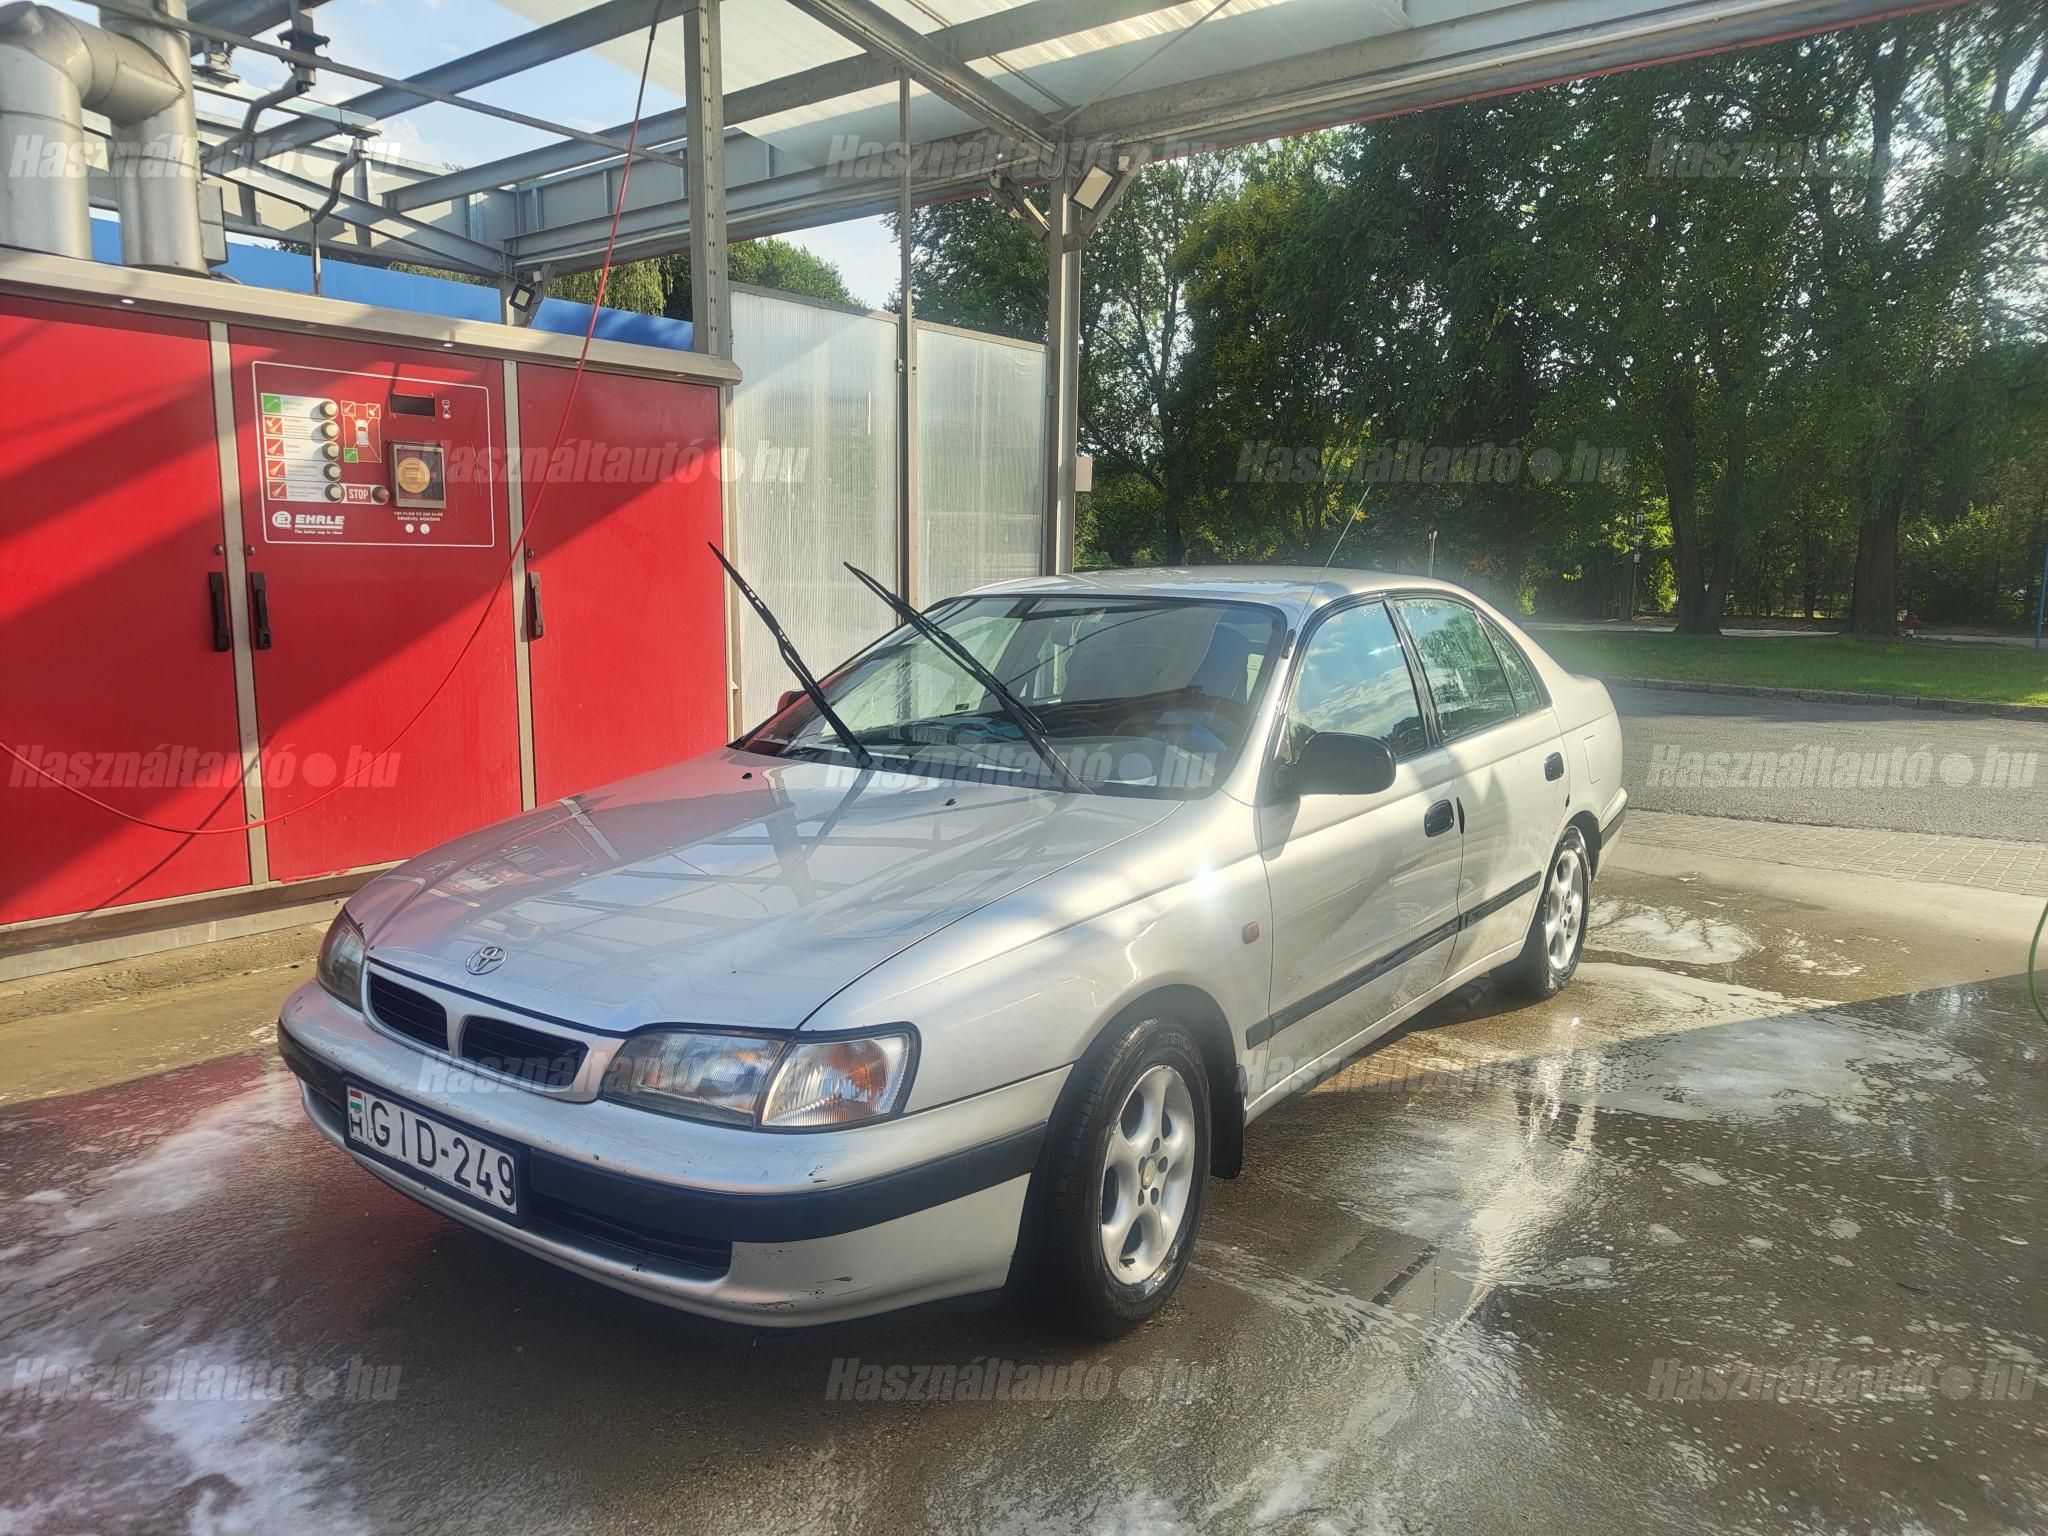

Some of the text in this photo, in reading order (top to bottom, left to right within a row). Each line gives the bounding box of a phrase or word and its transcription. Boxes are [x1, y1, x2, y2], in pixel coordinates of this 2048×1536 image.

[348, 488, 369, 499] STOP
[295, 514, 345, 525] EHRLE
[350, 1100, 515, 1206] H GID-249
